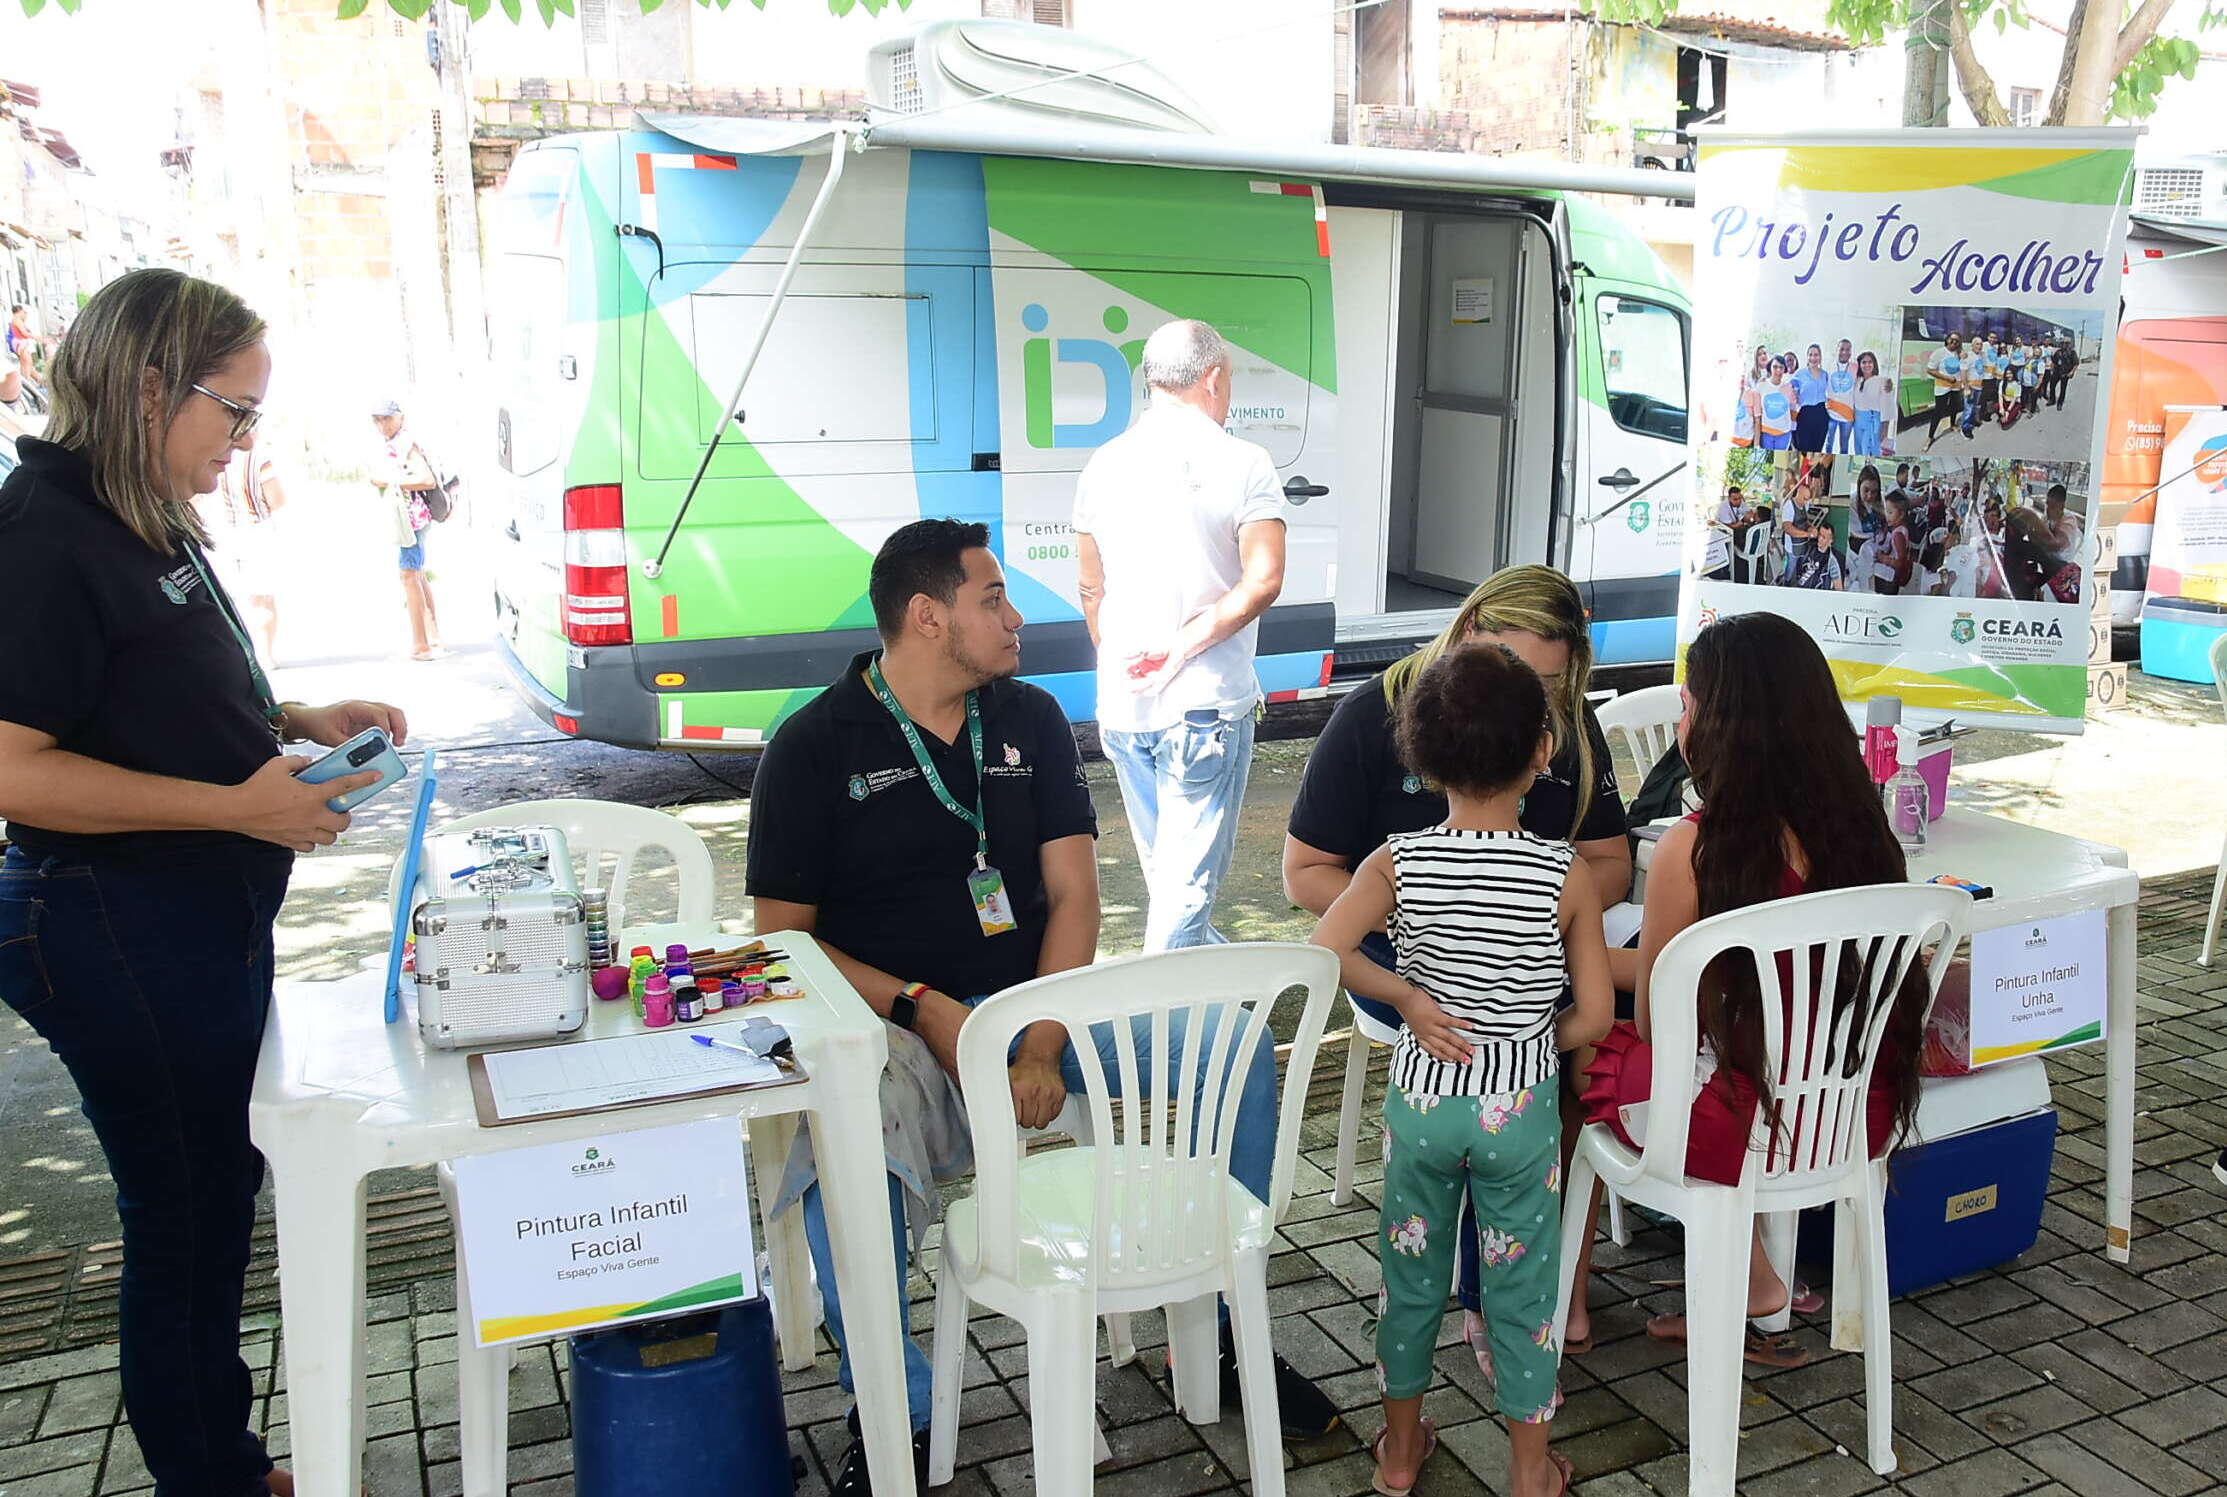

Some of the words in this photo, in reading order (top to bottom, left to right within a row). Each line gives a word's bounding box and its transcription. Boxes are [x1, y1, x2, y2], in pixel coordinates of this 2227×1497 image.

[1711, 203, 1919, 285] Projeto
[1910, 239, 2103, 294] Acolher
[1226, 407, 1285, 419] VIMENTO
[1025, 523, 1075, 536] Centra
[1028, 545, 1069, 560] 0800
[1982, 618, 2063, 638] CEARÁ
[1981, 635, 2019, 644] GOVERNO
[1995, 974, 2037, 992] Pintura
[2041, 963, 2079, 983] Infantil
[2022, 991, 2054, 1008] Unha
[571, 1157, 616, 1172] CEARÁ
[516, 1211, 603, 1239] Pintura
[610, 1194, 688, 1224] Infantil
[571, 1232, 642, 1261] Facial
[557, 1266, 598, 1281] Espaço
[600, 1262, 625, 1273] Viva
[627, 1255, 659, 1269] Gente
